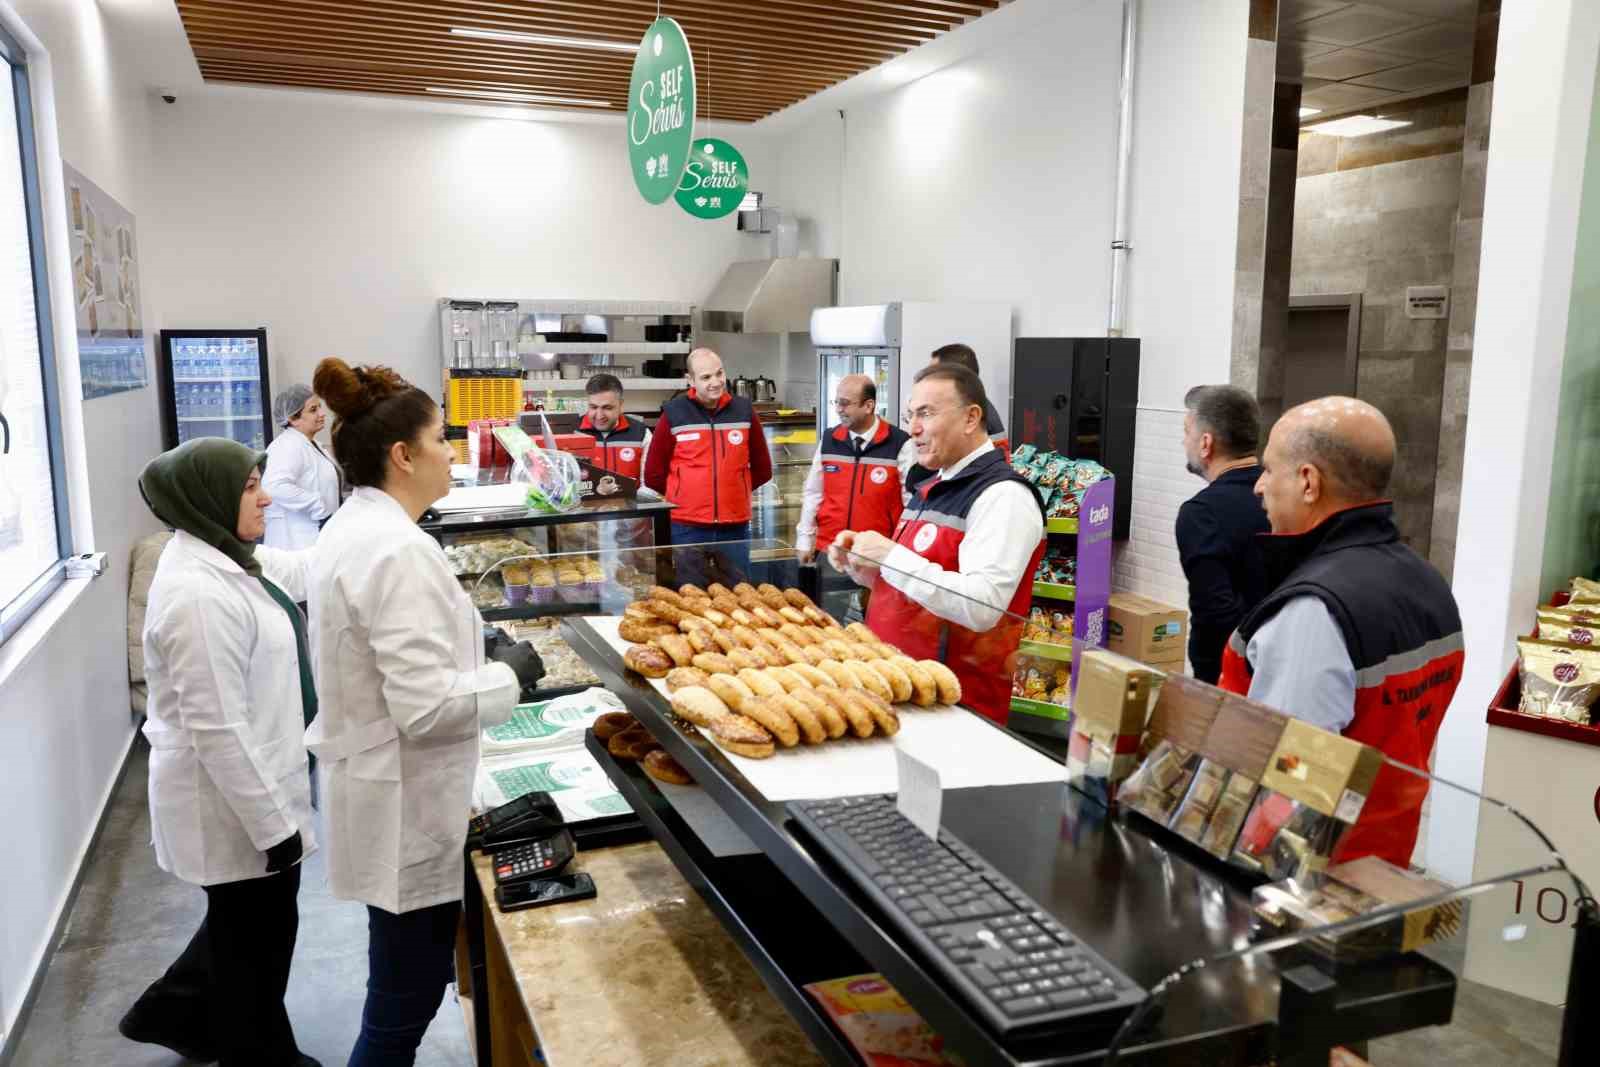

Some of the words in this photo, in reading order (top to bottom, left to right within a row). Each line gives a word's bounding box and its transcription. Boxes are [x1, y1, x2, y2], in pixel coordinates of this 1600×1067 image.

[660, 64, 684, 99] SELF
[631, 80, 685, 145] Servis
[678, 162, 739, 190] Servis
[711, 160, 737, 175] SELF
